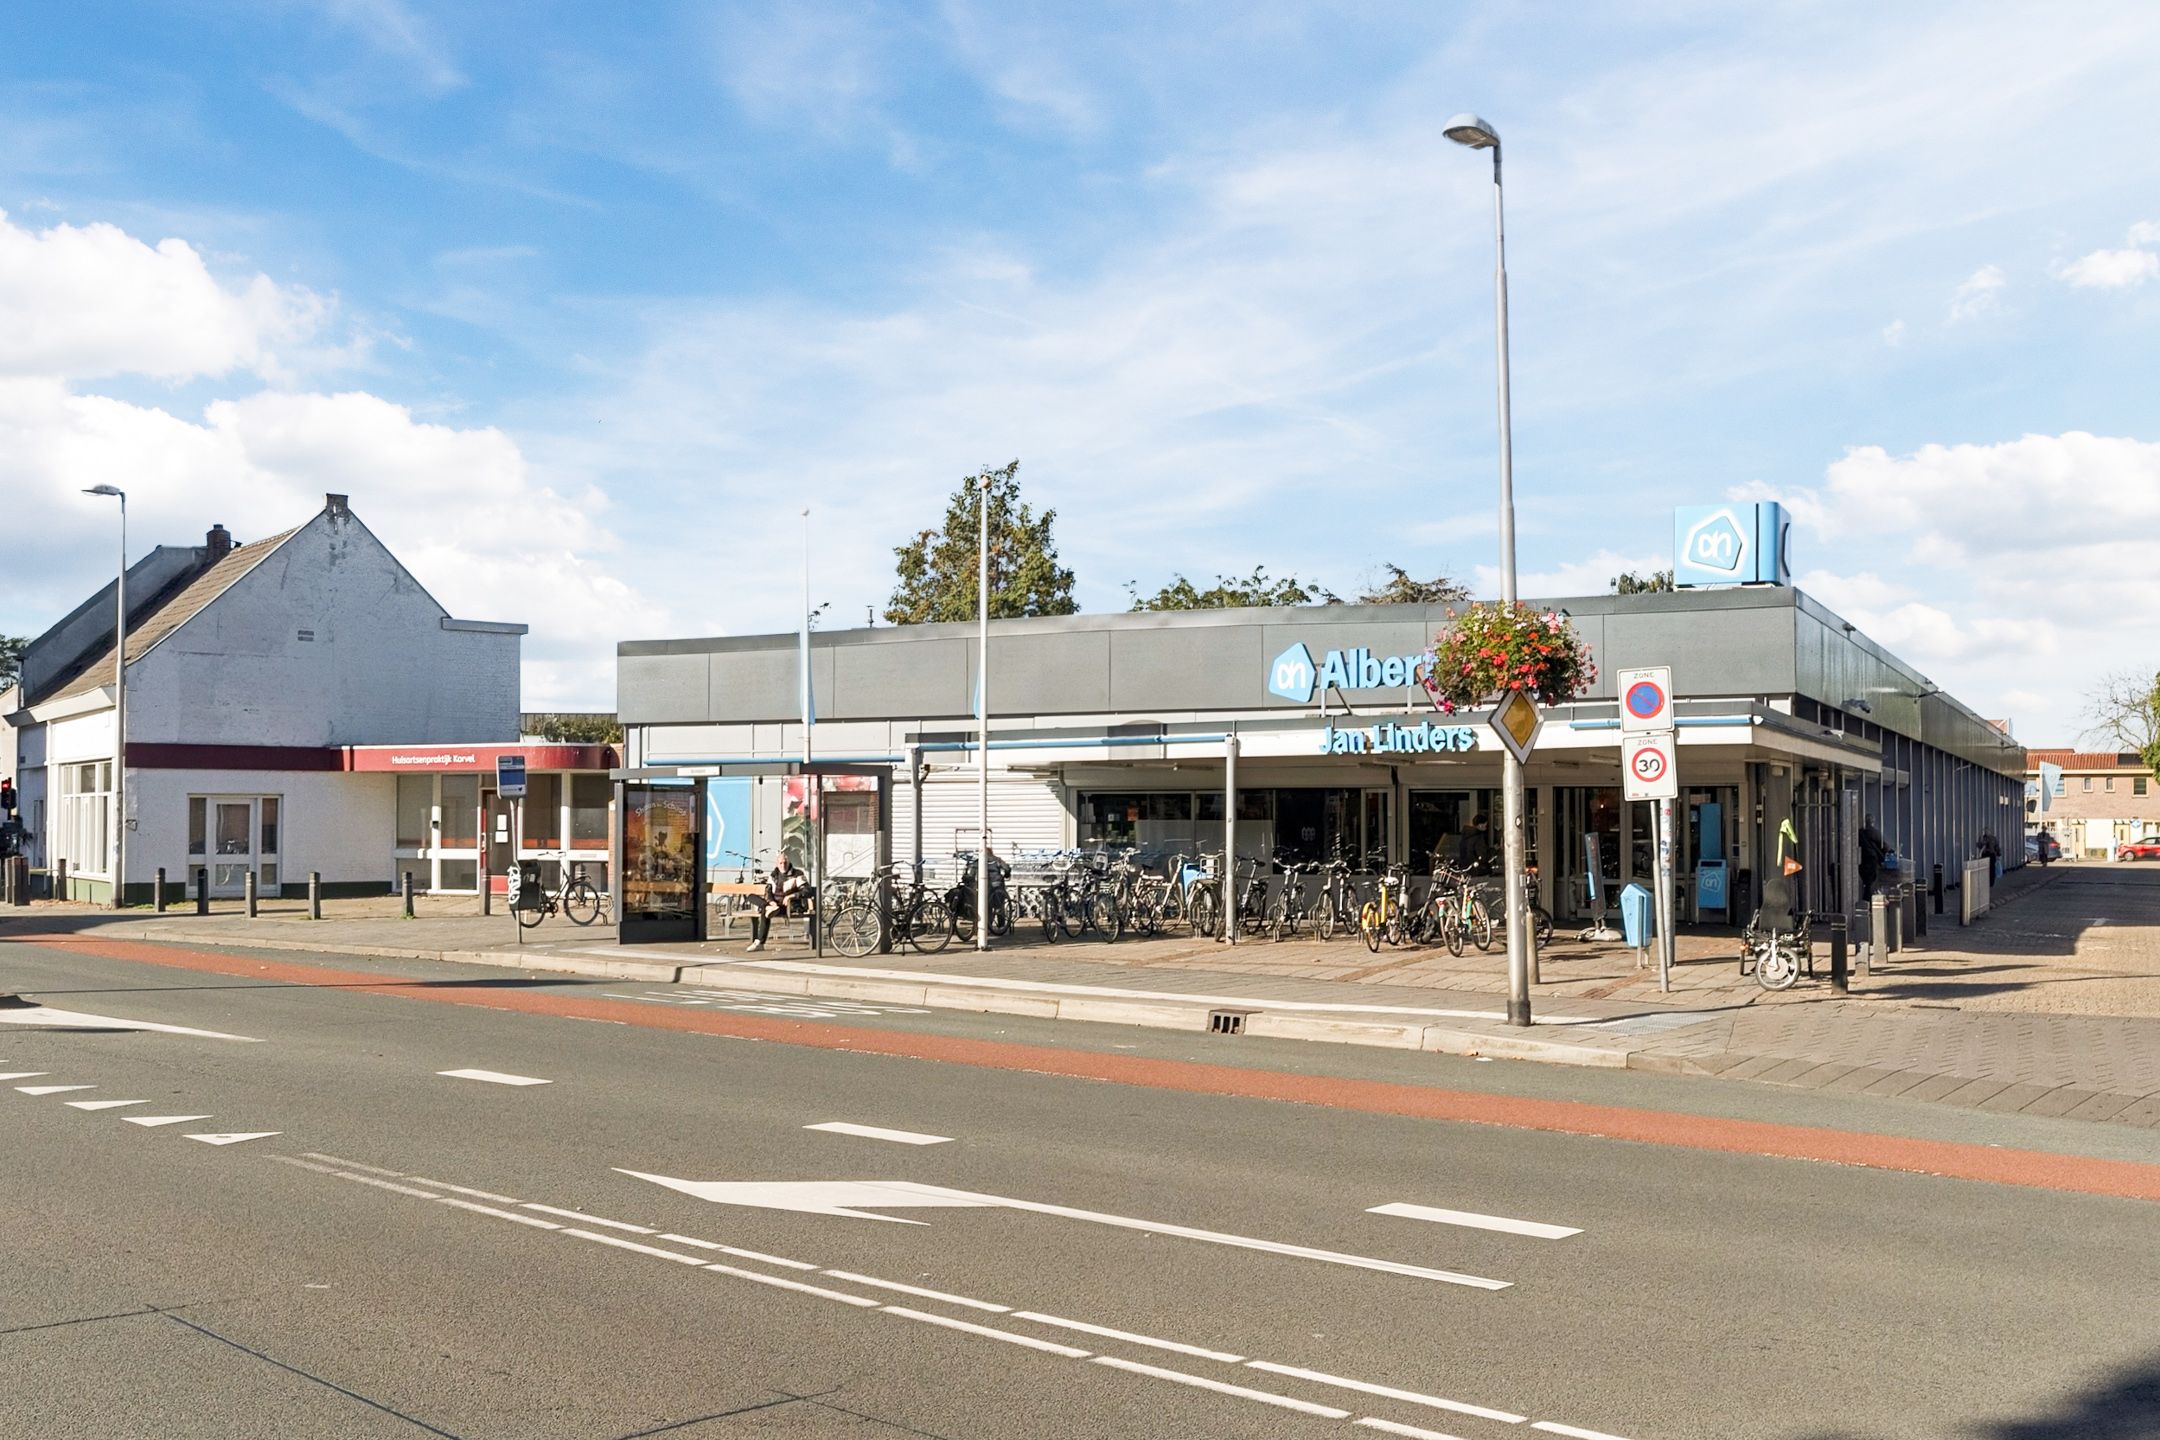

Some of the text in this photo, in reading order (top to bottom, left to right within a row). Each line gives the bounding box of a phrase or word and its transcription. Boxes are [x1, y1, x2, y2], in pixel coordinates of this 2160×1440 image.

[1633, 671, 1655, 680] ZONE
[1319, 721, 1476, 755] Jan Linders
[1637, 738, 1658, 746] ZONE
[391, 754, 476, 766] Huisartsenpraktijk Korvel
[1638, 758, 1660, 773] 30
[717, 1001, 932, 1018] BUS
